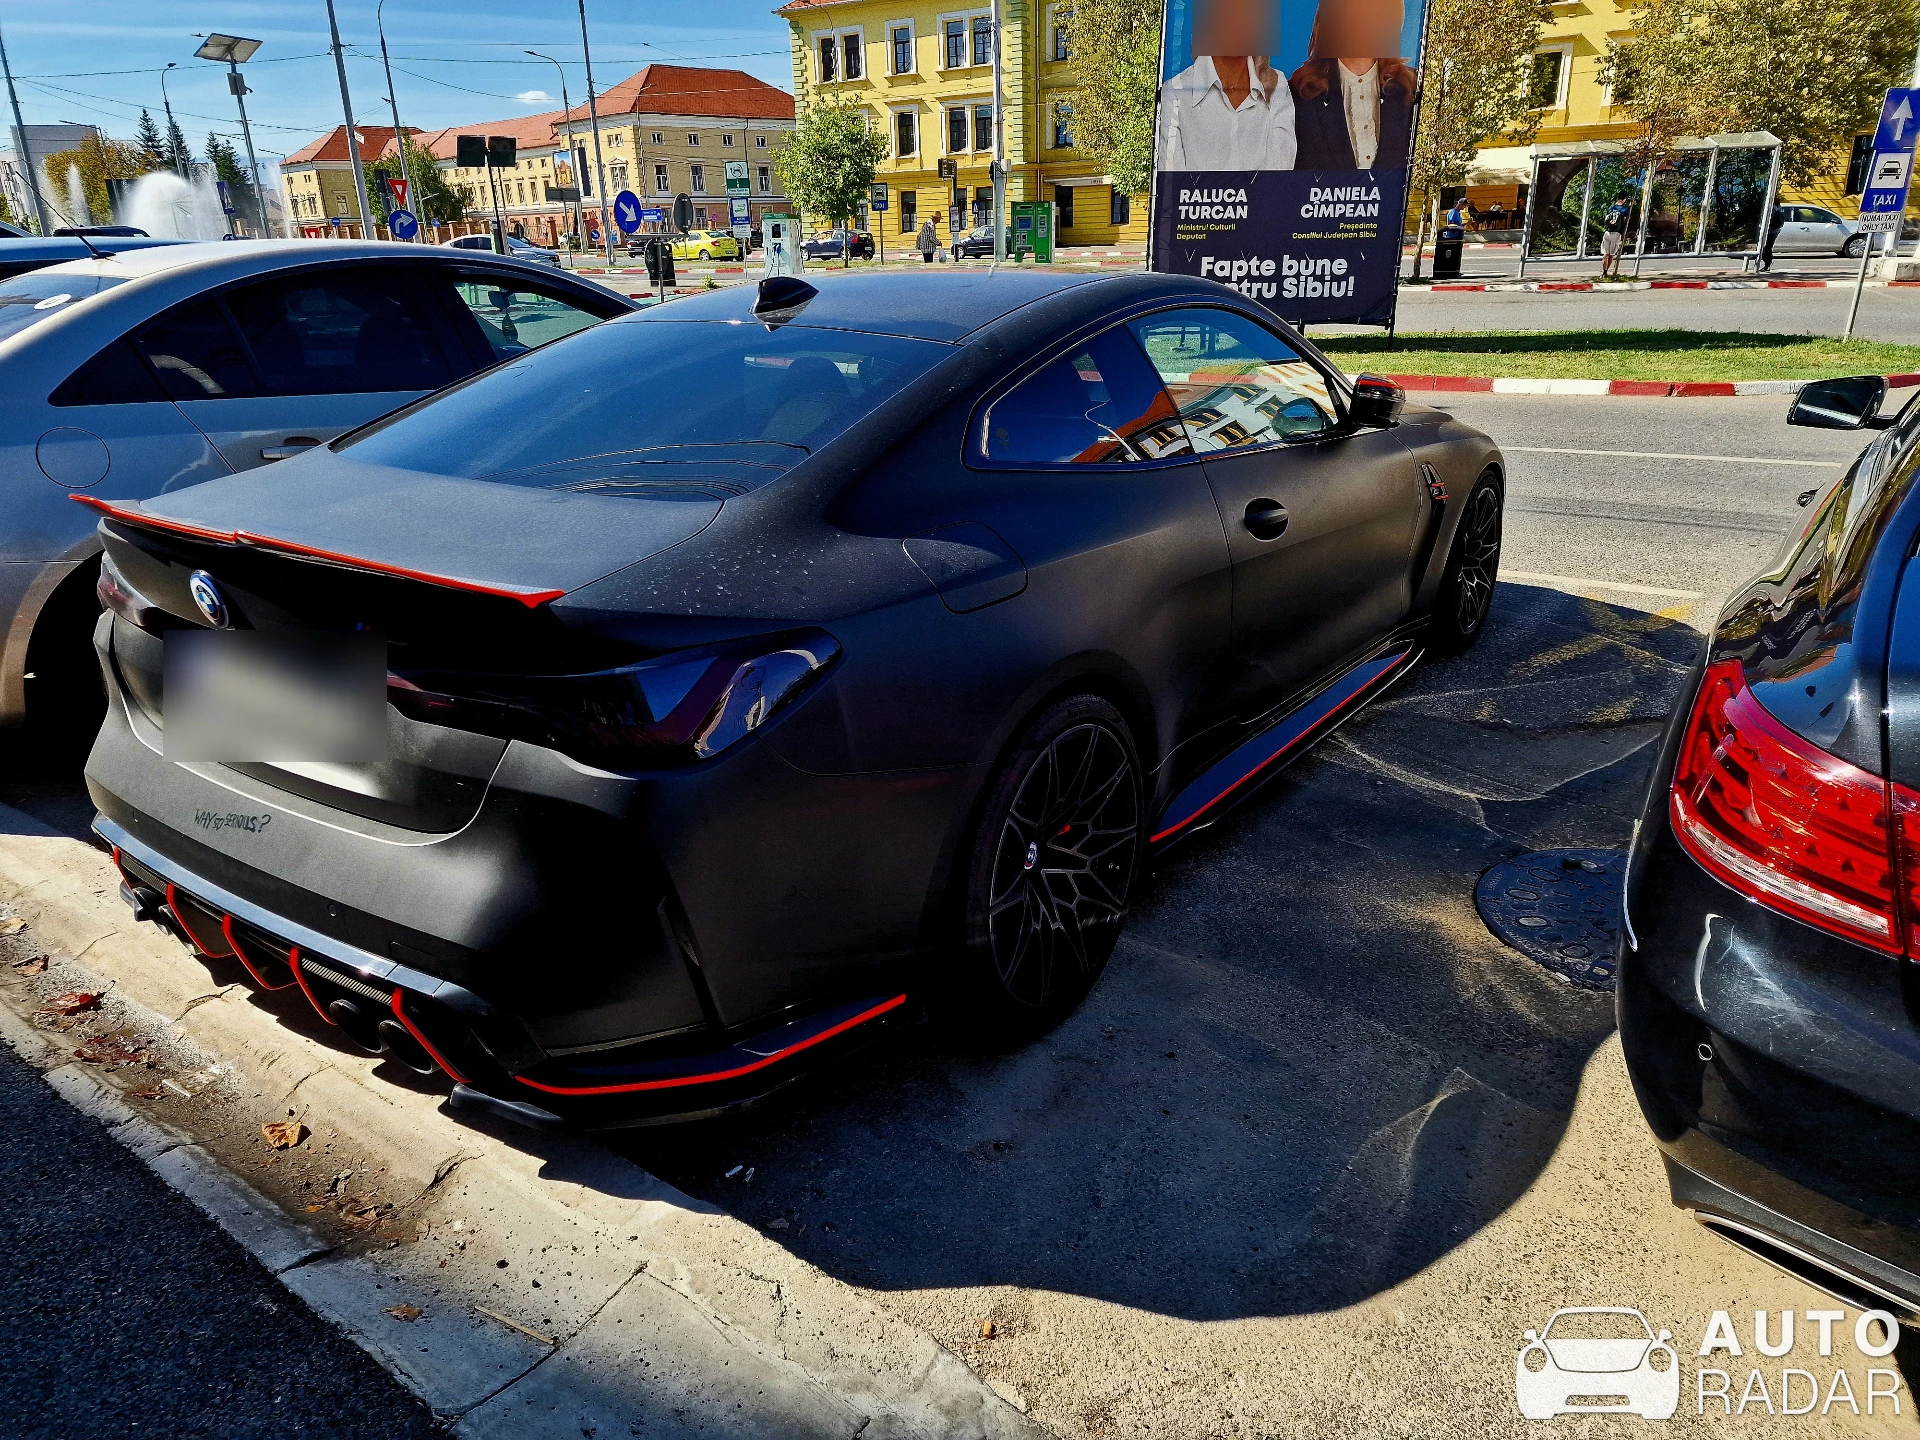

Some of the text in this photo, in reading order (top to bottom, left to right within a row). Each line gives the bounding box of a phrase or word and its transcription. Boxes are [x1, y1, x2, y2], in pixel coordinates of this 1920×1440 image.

[1180, 188, 1248, 203] RALUCA
[1309, 186, 1381, 202] DANIELA
[1873, 194, 1897, 205] TAXI
[1178, 205, 1248, 220] TURCAN
[1300, 200, 1379, 218] CÎMPEAN
[1176, 223, 1236, 231] Ministrul Culturii
[1881, 222, 1895, 230] TAXI
[1176, 233, 1206, 241] Deputat
[1201, 254, 1348, 281] Fapte bune
[1224, 275, 1355, 299] tru Sibiu!
[194, 809, 217, 830] WHY
[212, 817, 225, 831] SO
